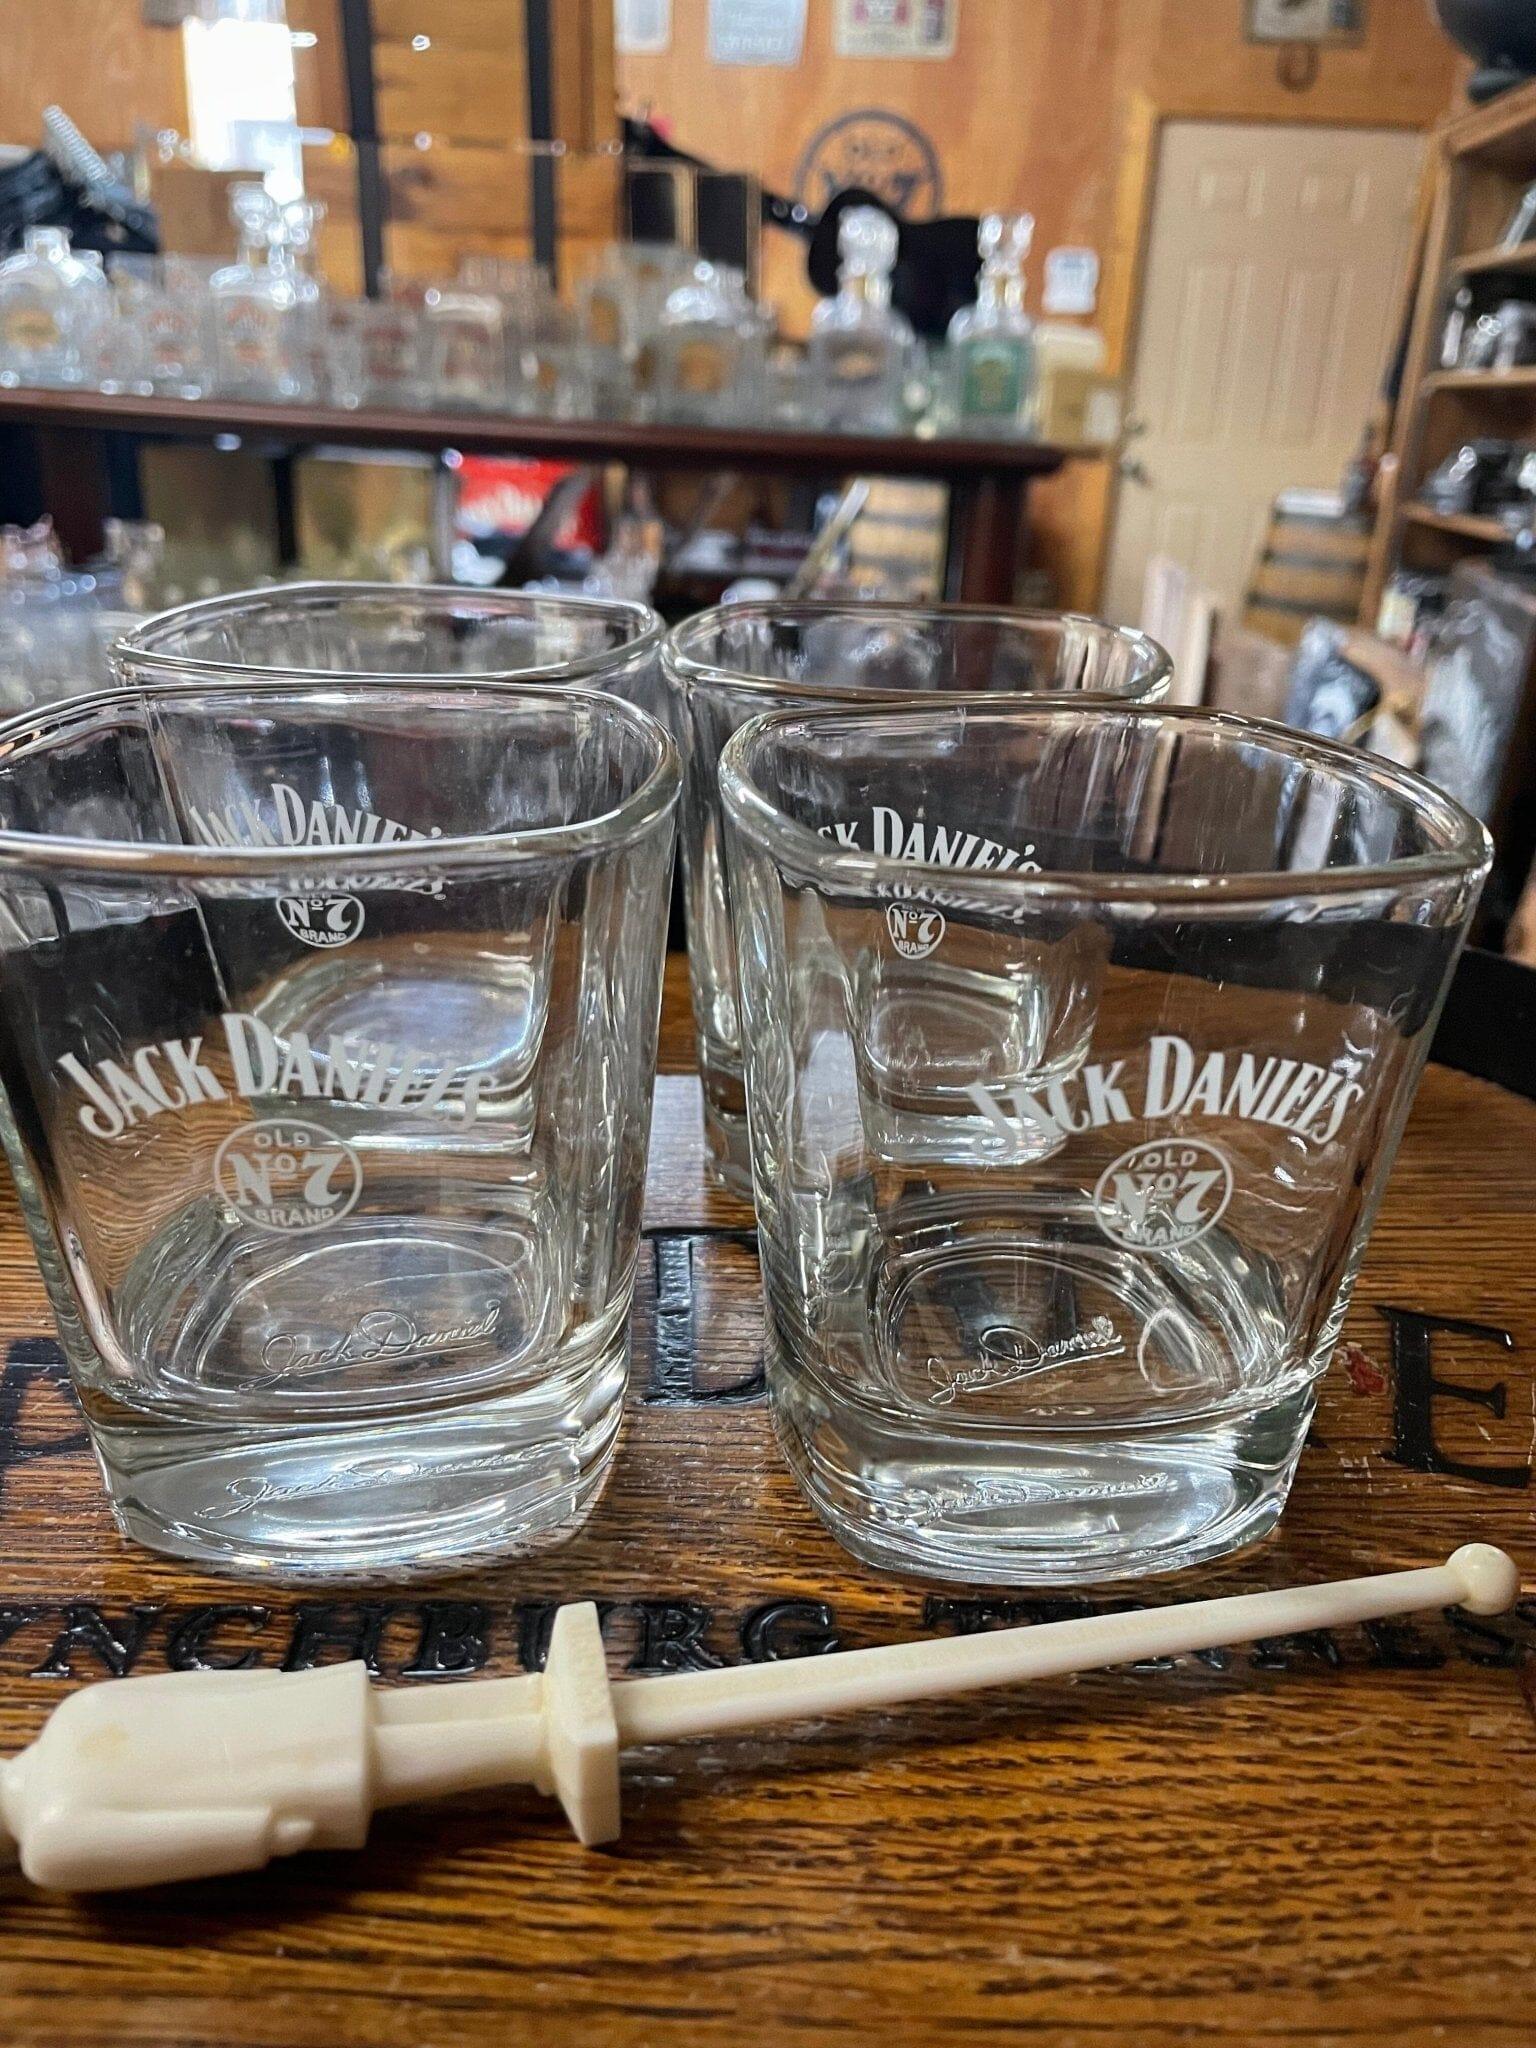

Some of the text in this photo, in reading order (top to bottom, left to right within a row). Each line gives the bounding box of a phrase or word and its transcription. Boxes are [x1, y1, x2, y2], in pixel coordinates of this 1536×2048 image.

[300, 928, 347, 943] BRAND
[57, 1036, 229, 1139] JACK
[965, 1060, 1135, 1153] JACK
[254, 1131, 312, 1148] OLD
[1142, 1148, 1197, 1169] OLD
[254, 1207, 334, 1225] BRAND
